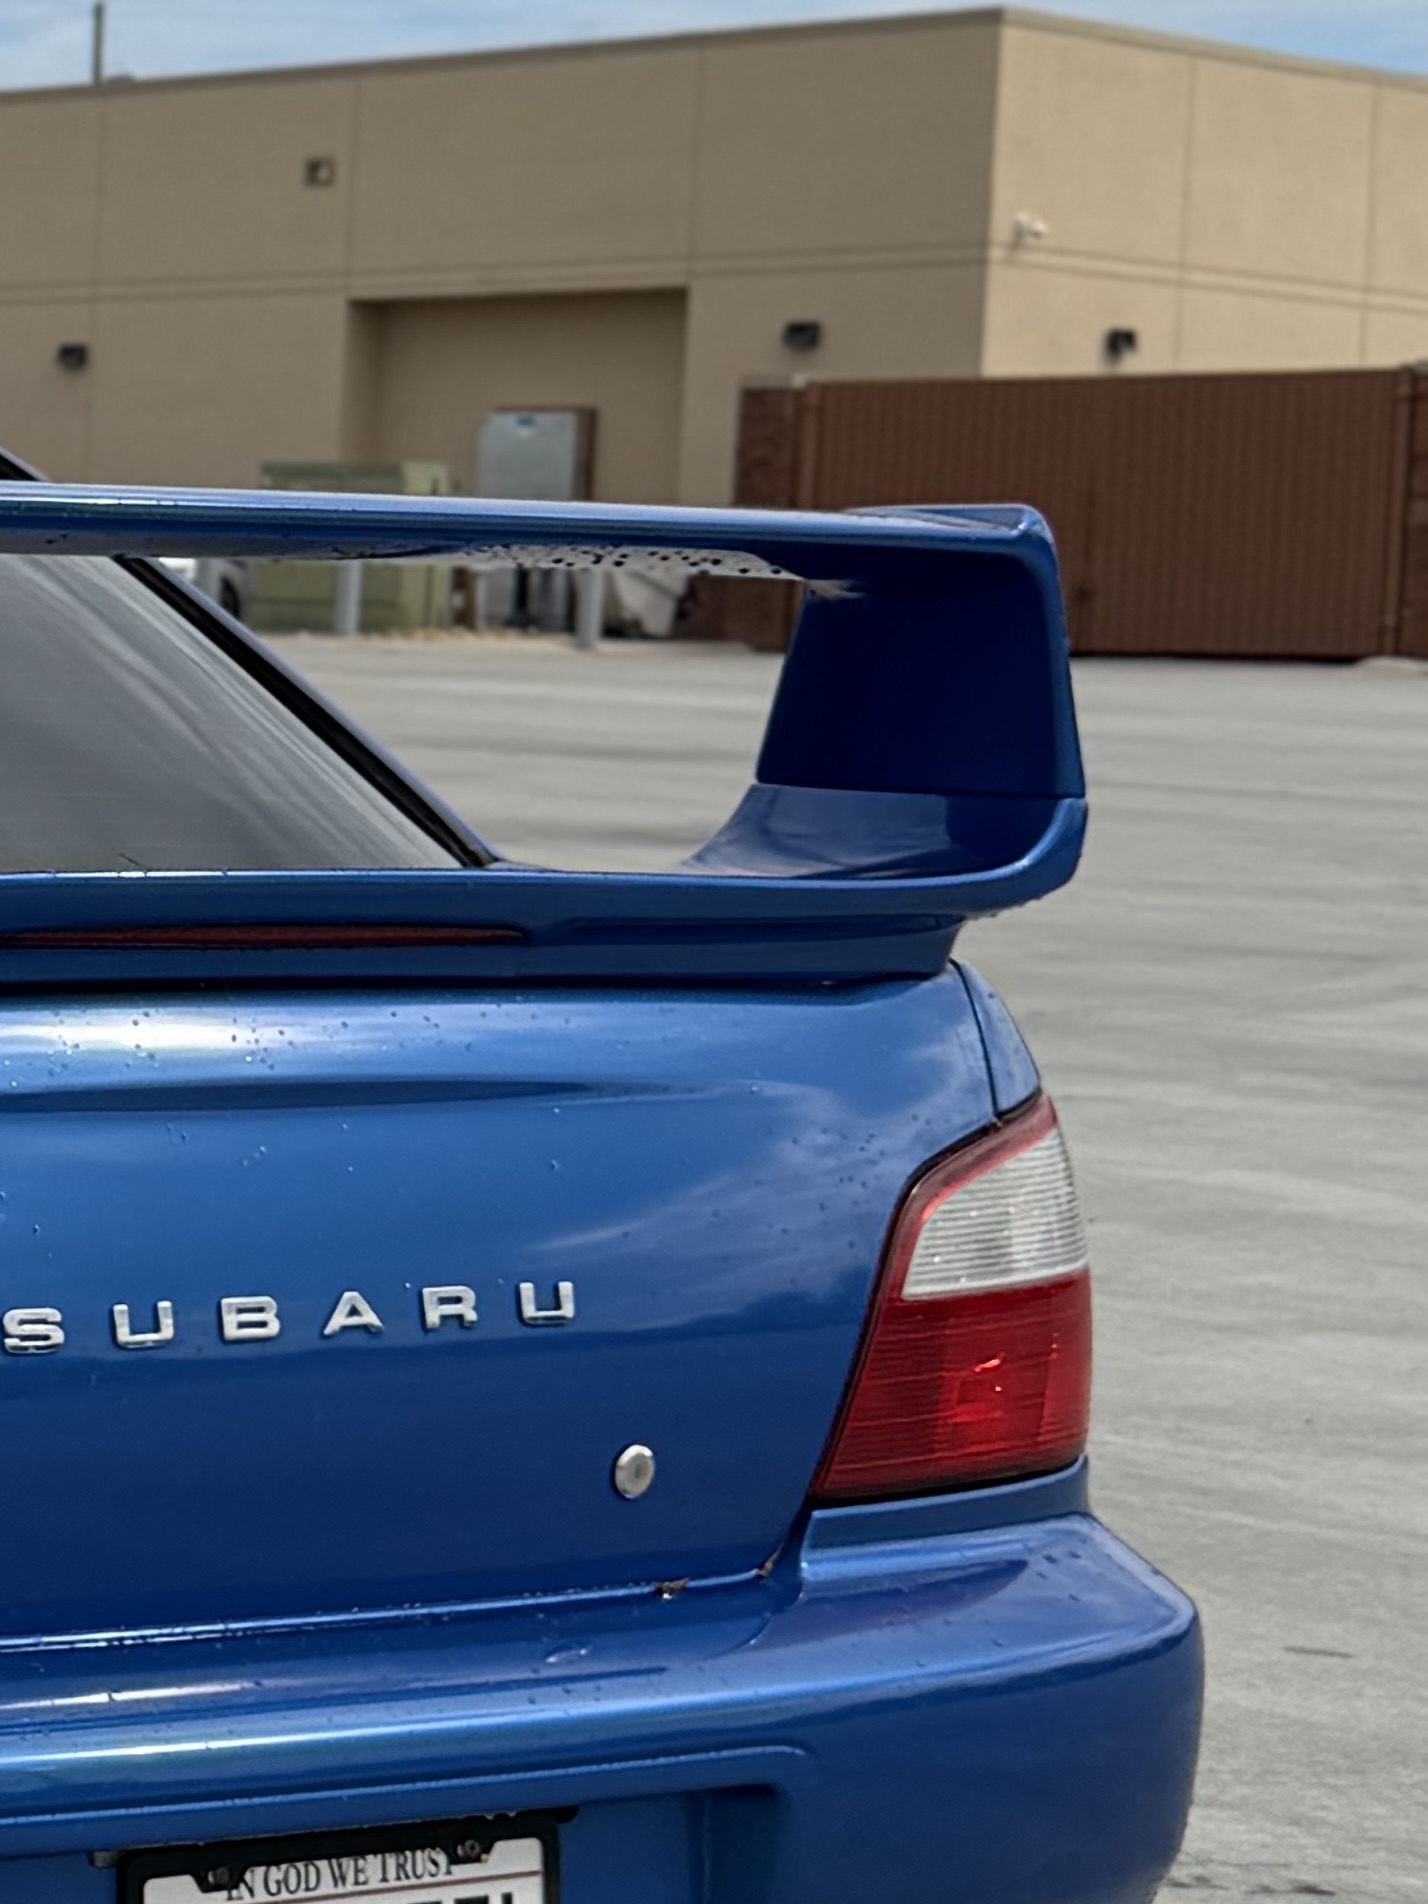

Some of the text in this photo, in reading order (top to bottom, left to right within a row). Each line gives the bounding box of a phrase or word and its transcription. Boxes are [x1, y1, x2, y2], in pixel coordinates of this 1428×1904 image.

[2, 1281, 575, 1354] SUBARU
[263, 1861, 321, 1897] GOD
[327, 1856, 369, 1889] WE
